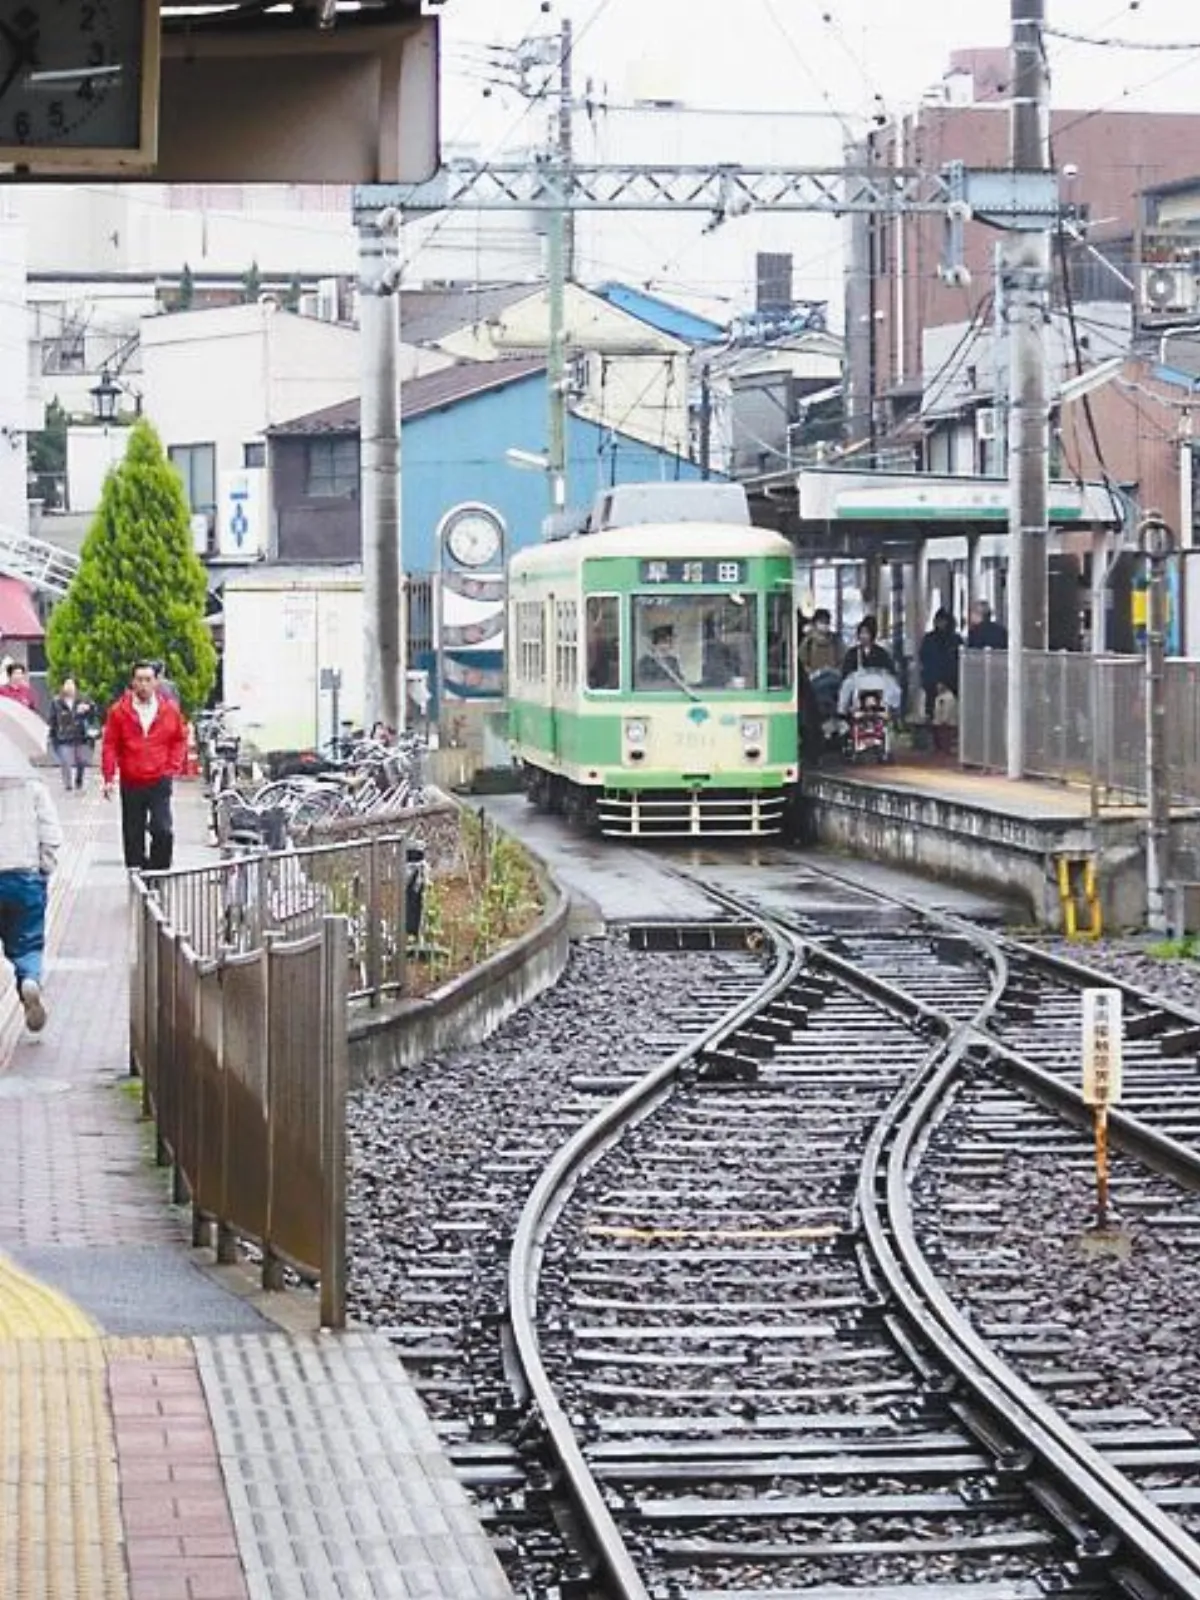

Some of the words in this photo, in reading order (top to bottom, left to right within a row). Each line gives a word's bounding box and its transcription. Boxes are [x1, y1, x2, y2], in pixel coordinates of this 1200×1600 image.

[80, 4, 96, 31] 2
[87, 41, 104, 67] 3
[75, 77, 95, 101] 4
[14, 110, 30, 138] 6
[48, 100, 64, 127] 5
